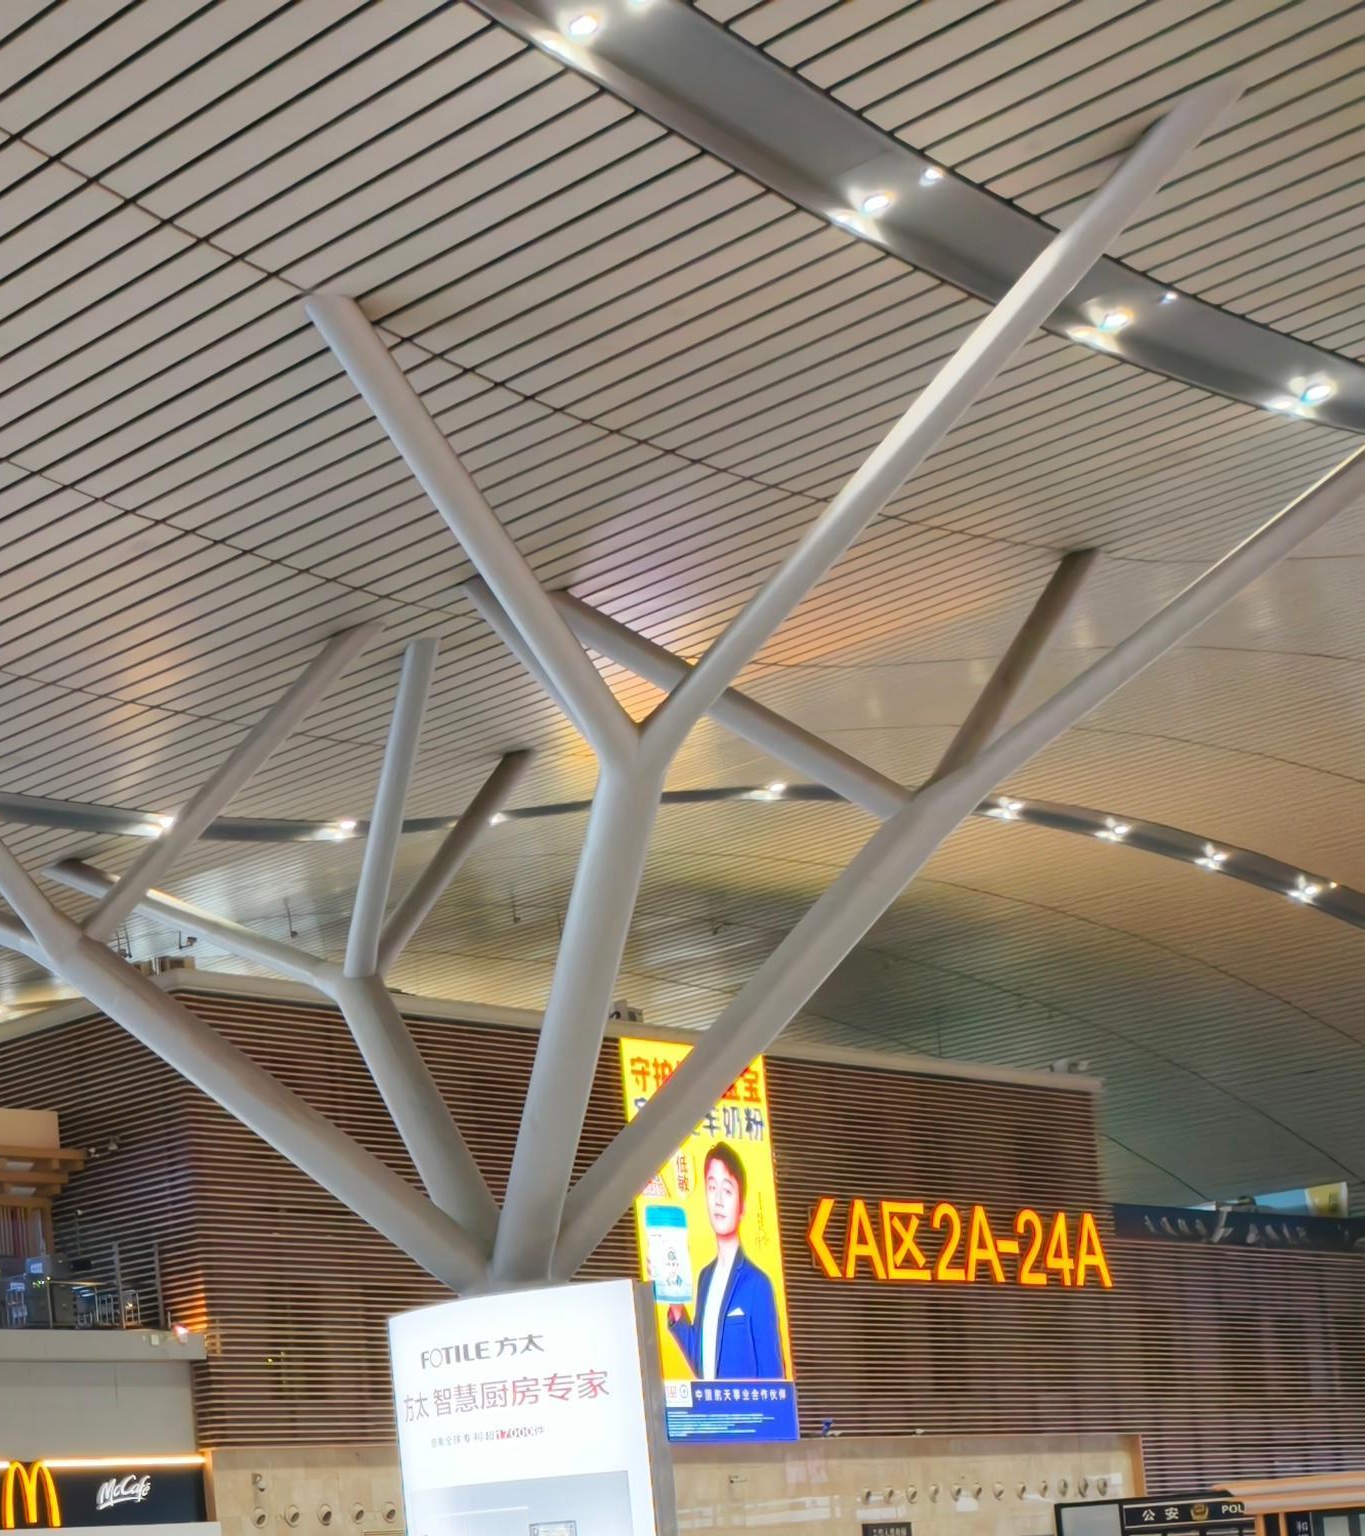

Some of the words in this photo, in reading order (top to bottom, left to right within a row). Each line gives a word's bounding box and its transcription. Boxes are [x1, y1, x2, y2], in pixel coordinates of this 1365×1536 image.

[420, 1342, 491, 1369] FOTILE
[495, 1334, 545, 1357] 方太
[1142, 1507, 1179, 1522] 公安
